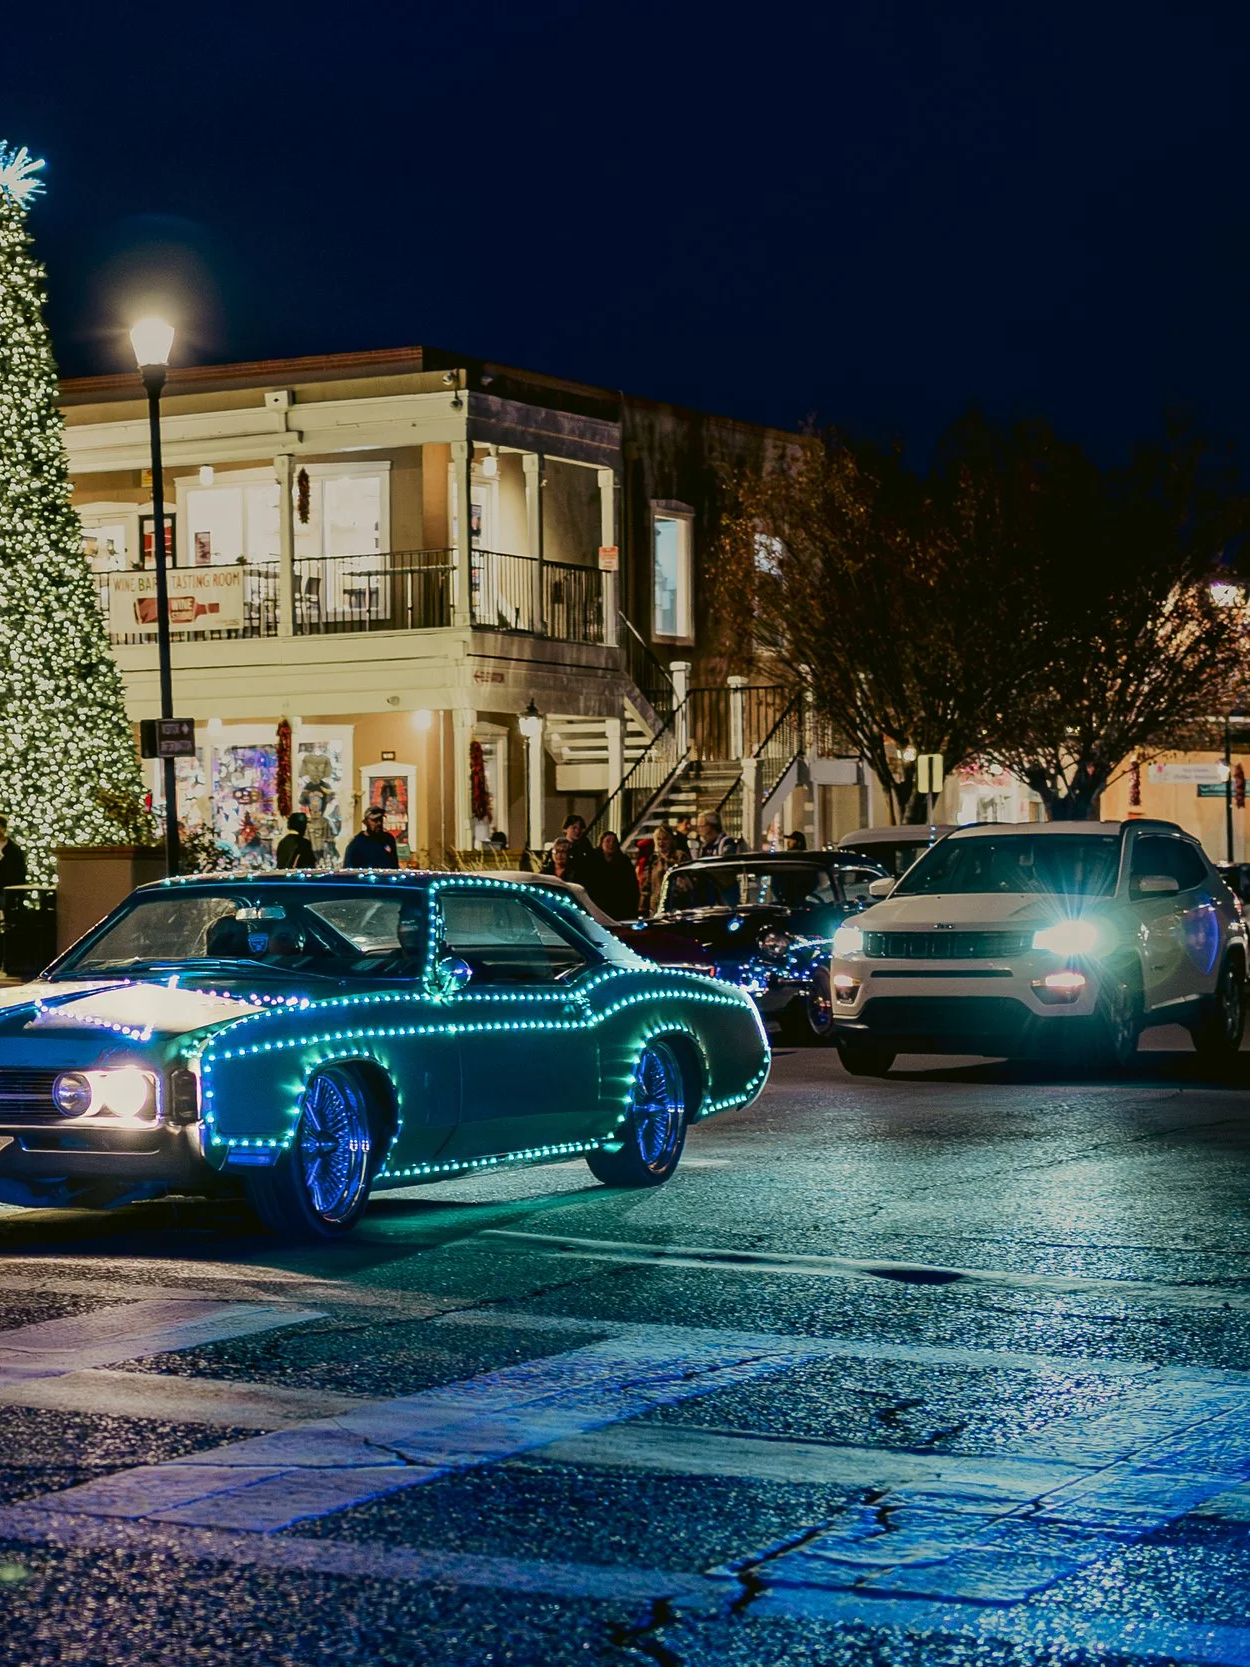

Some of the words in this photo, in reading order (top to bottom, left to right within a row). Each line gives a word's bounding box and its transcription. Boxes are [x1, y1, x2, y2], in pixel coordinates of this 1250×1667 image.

[113, 578, 136, 592] WINE
[171, 574, 211, 589] TASTING
[213, 572, 240, 586] ROOM
